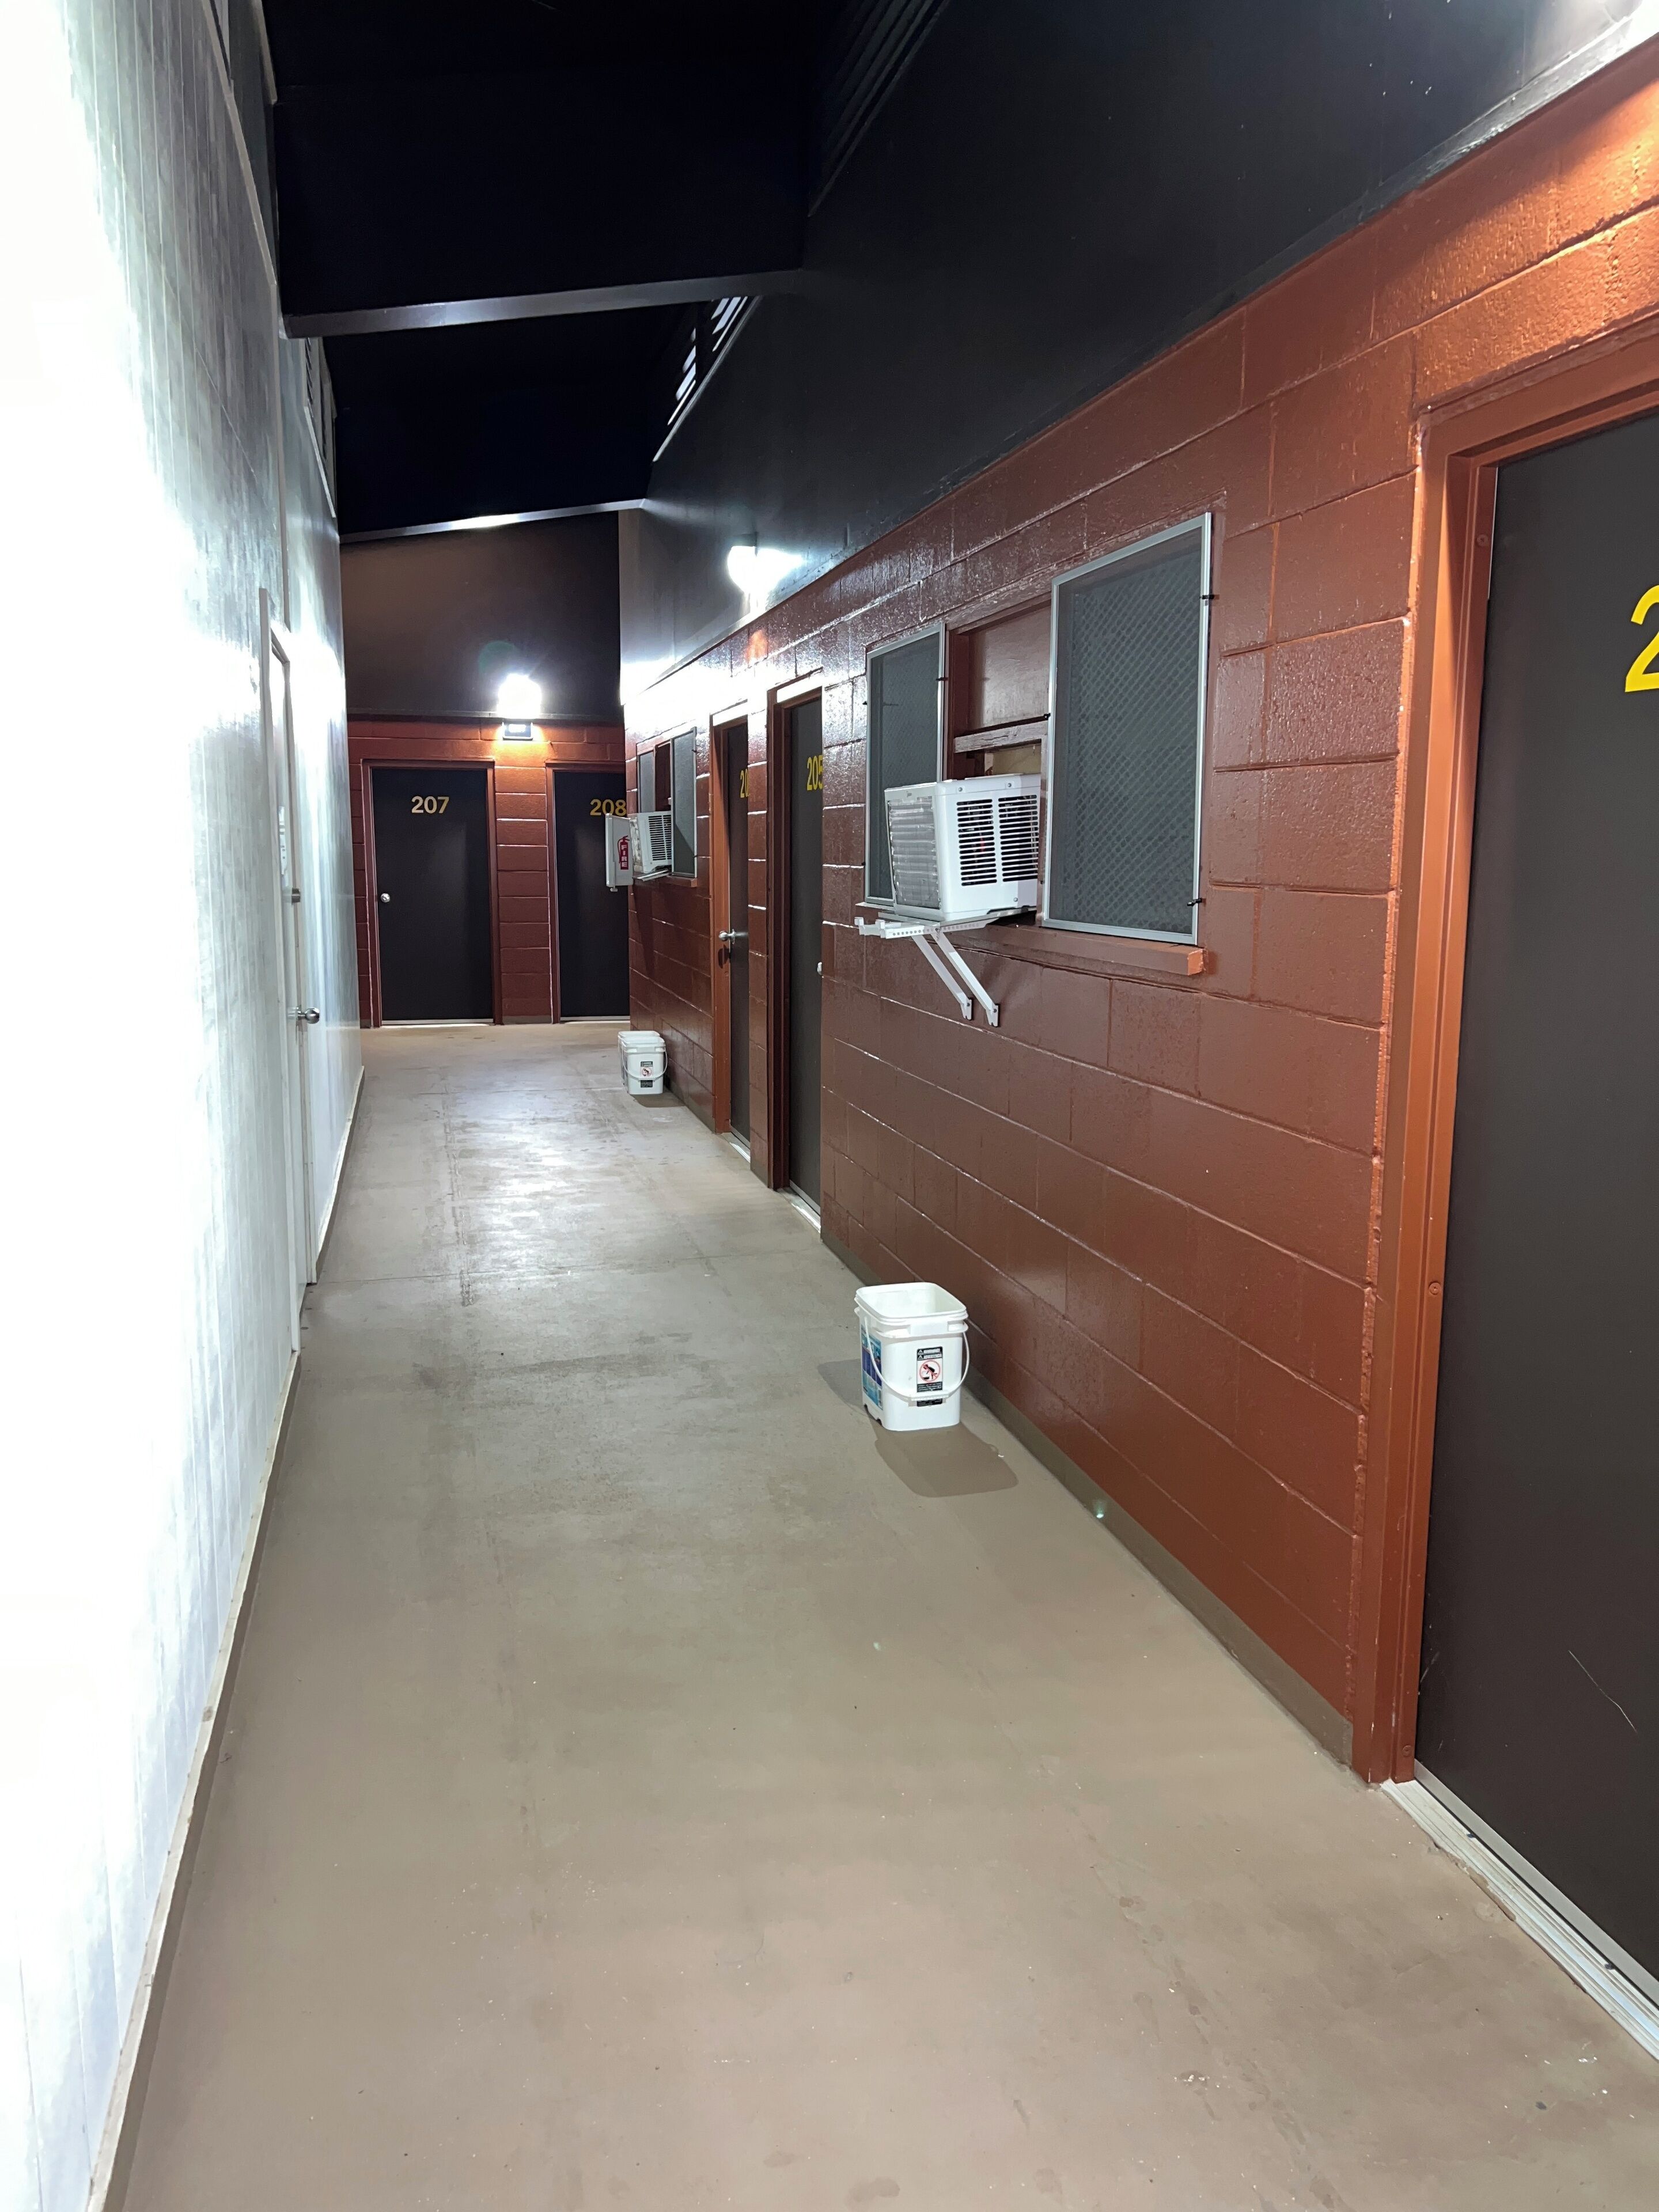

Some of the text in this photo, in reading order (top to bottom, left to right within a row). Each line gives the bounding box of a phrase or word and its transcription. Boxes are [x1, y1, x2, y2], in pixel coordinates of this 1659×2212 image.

[740, 768, 749, 798] 20
[806, 755, 823, 791] 205
[411, 796, 449, 814] 207
[590, 799, 627, 816] 208
